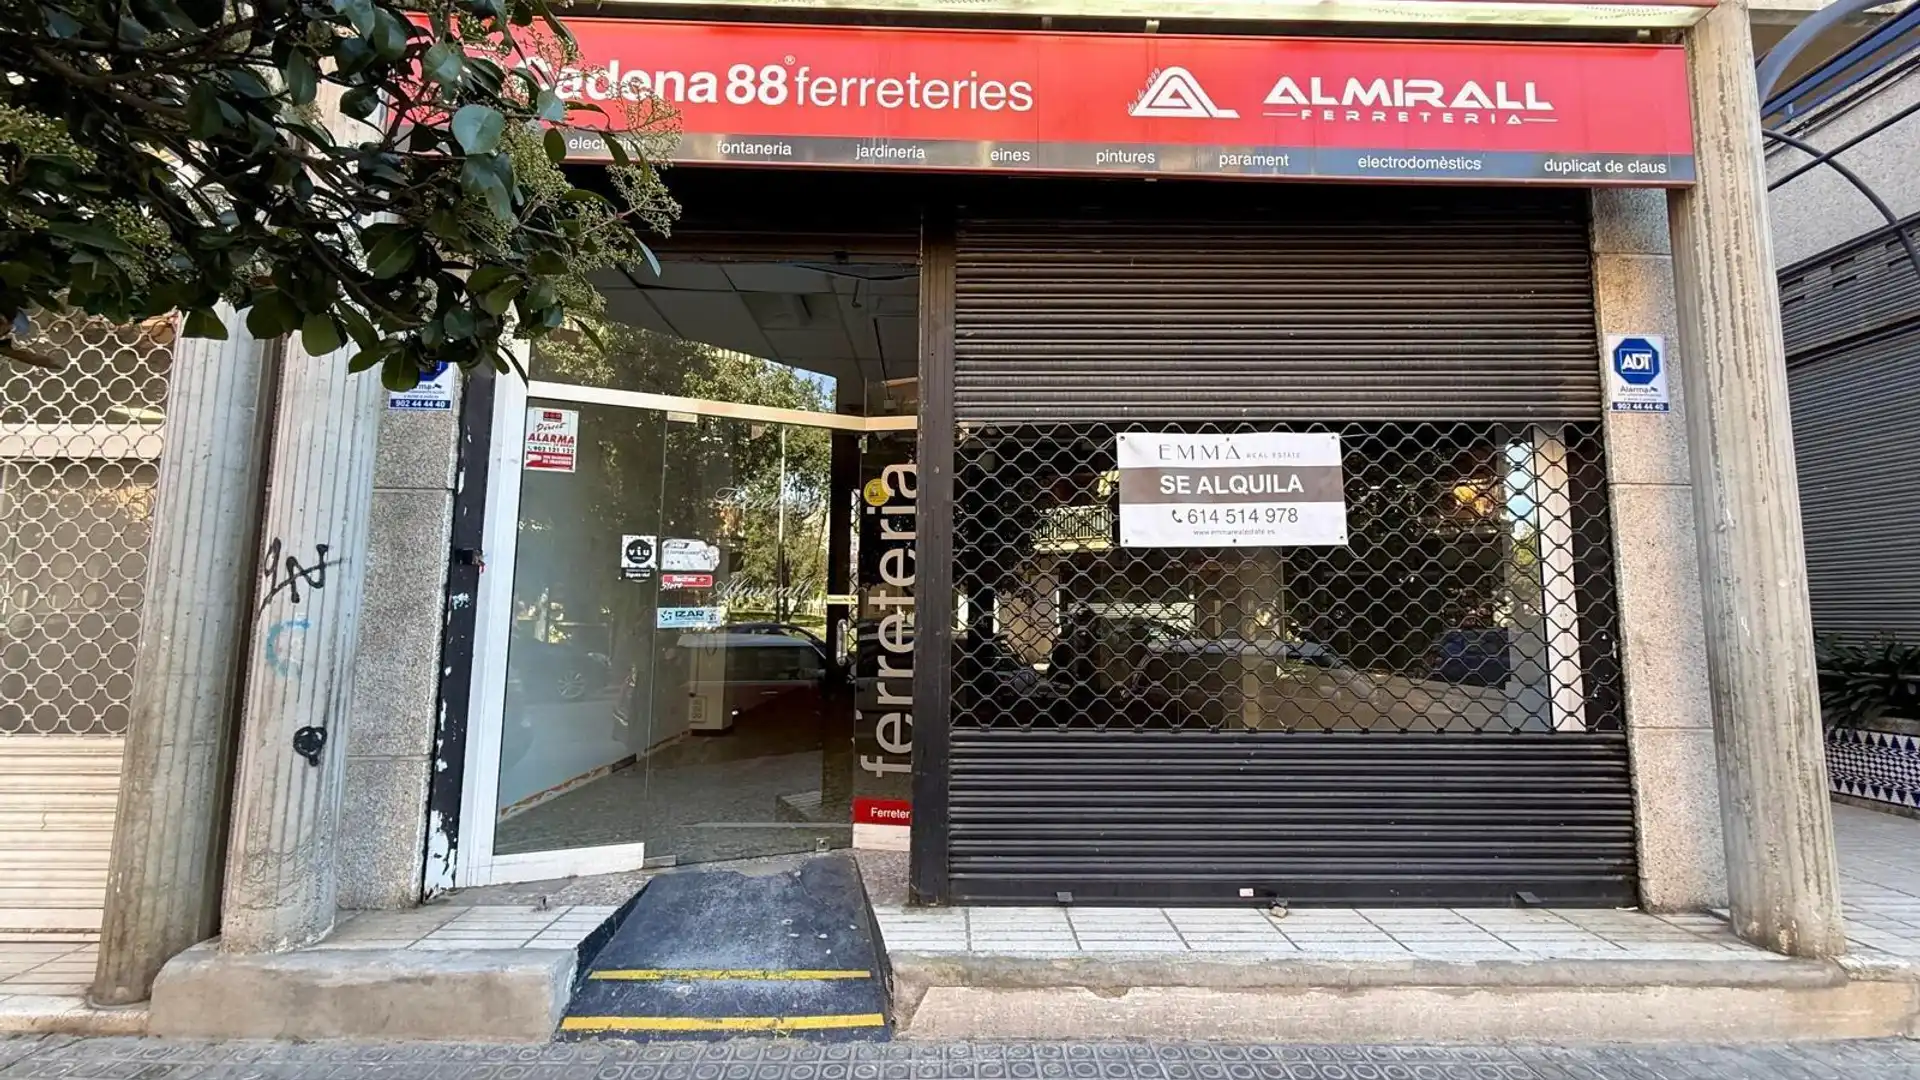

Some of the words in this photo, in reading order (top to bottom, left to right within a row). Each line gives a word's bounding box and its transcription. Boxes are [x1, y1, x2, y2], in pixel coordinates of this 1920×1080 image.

[795, 66, 1034, 112] ferreteries
[1262, 75, 1555, 110] ALMIRALL
[1301, 109, 1523, 125] FERRETERIA
[716, 140, 792, 155] fontaneria
[855, 143, 926, 160] jardineria
[990, 147, 1031, 162] eines
[1095, 149, 1156, 165] pintures
[1219, 152, 1289, 168] parament
[1358, 155, 1482, 171] electrodomèstics
[1543, 158, 1602, 175] duplicat
[1605, 159, 1624, 173] de
[1628, 159, 1667, 174] claus
[1622, 353, 1652, 370] ADT
[411, 400, 422, 408] 44
[423, 400, 434, 408] 44
[528, 433, 575, 444] ALARMA
[1158, 444, 1241, 461] EMMA
[1159, 475, 1191, 494] SE
[1196, 474, 1305, 495] ALQUILA
[1187, 508, 1219, 524] 614
[1226, 508, 1259, 524] 514
[1265, 507, 1299, 524] 978
[628, 546, 650, 556] viu
[861, 463, 917, 778] ferreteria
